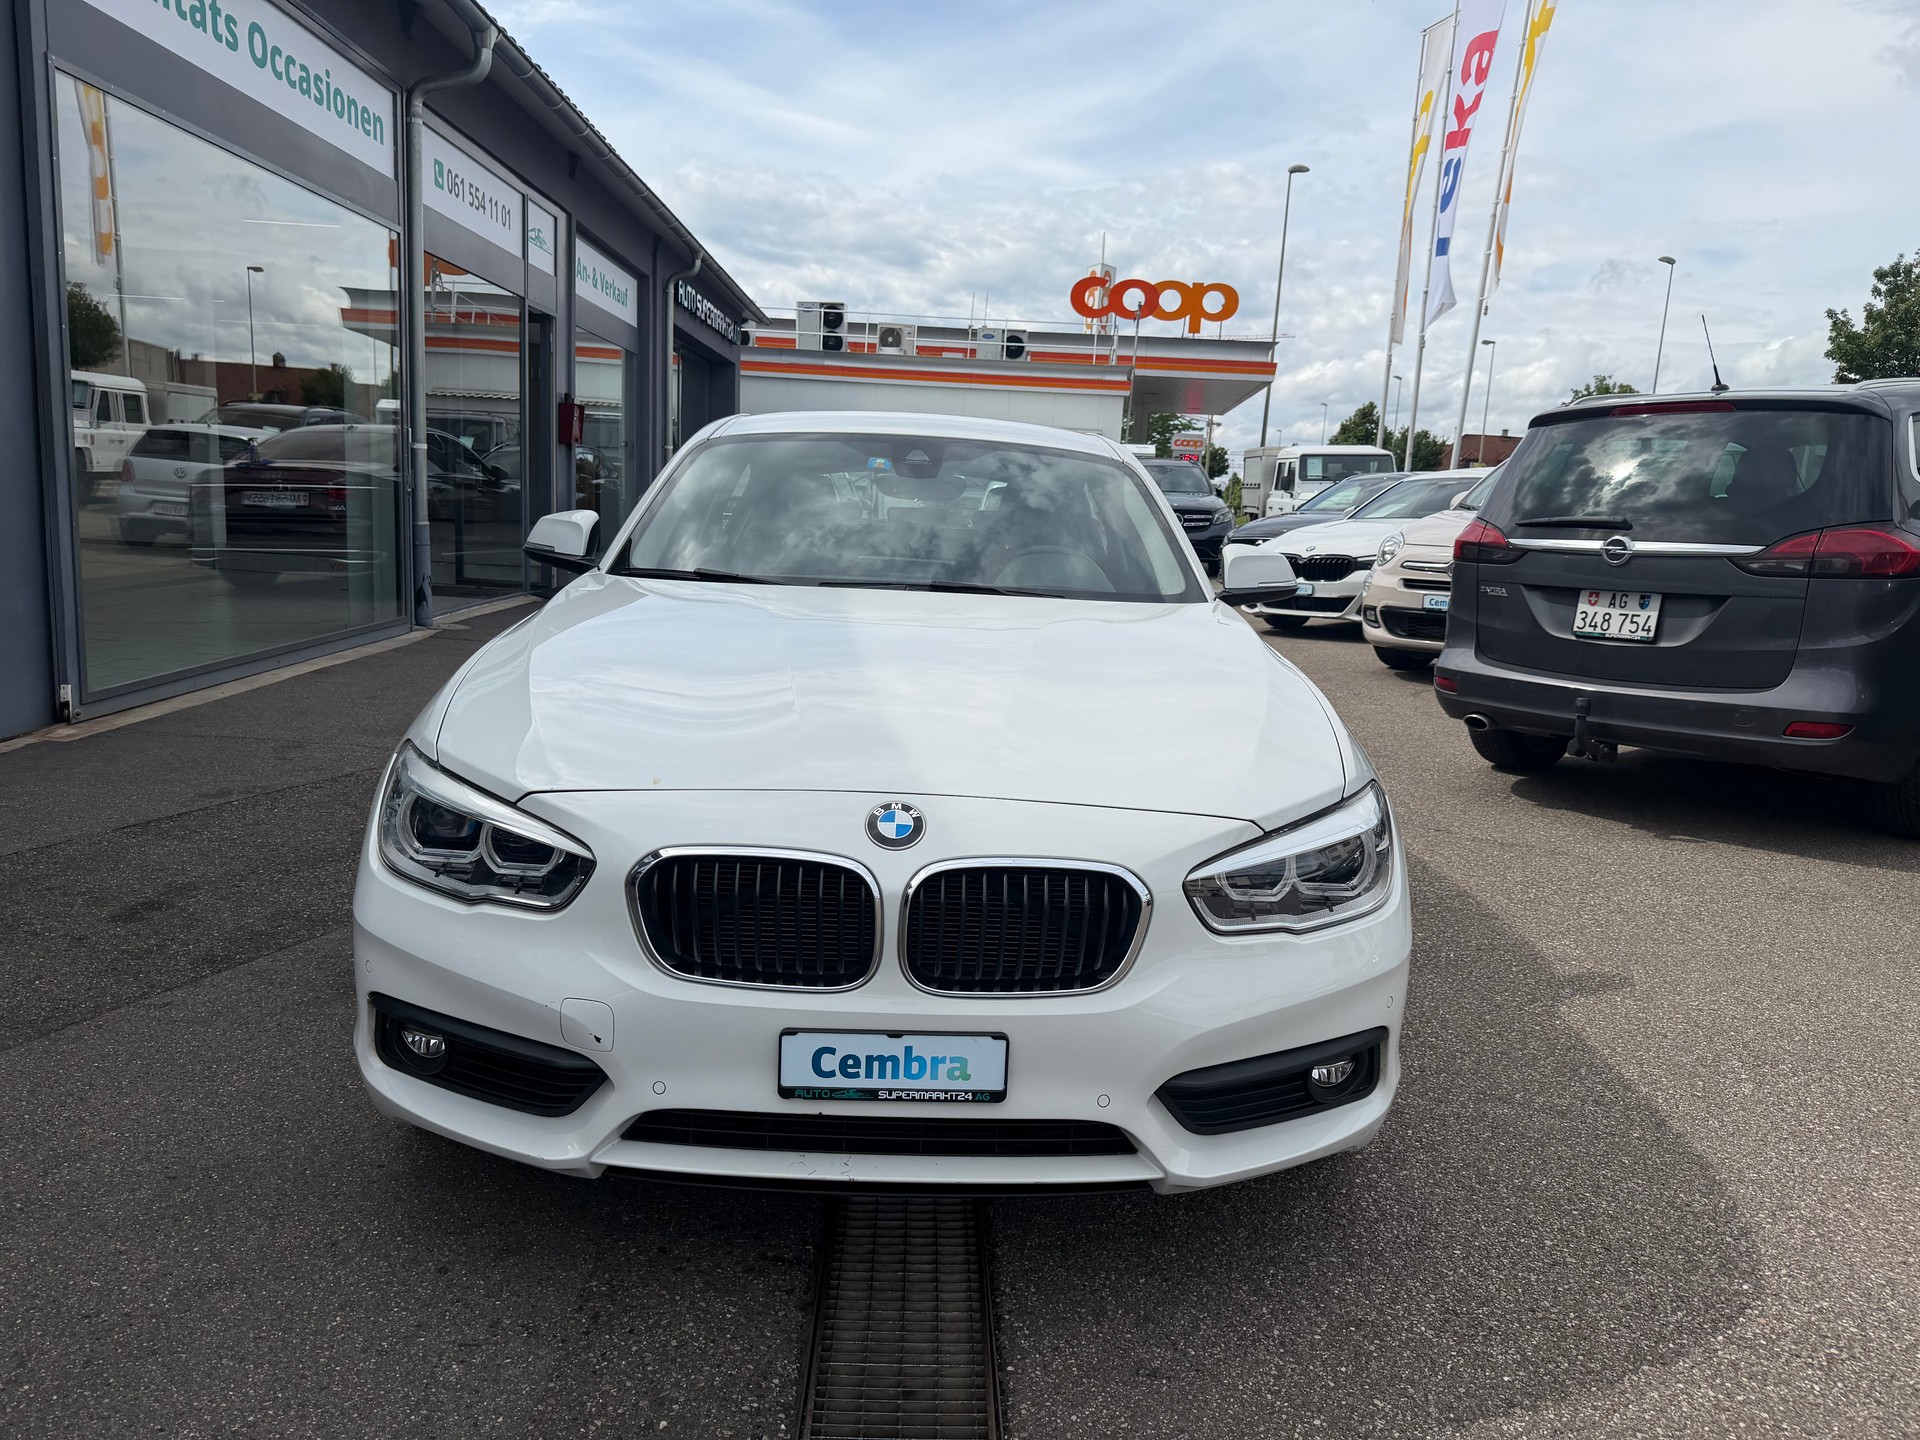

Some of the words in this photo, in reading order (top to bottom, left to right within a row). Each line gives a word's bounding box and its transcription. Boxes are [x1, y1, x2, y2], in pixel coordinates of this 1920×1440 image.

[247, 21, 384, 146] Occasionen
[446, 168, 465, 202] 061
[468, 182, 486, 215] 554
[488, 196, 499, 223] 11
[501, 204, 511, 231] 01
[576, 256, 591, 284] An-
[592, 266, 599, 290] &
[600, 271, 629, 308] Verkauf
[678, 279, 697, 313] AUTO
[1070, 276, 1240, 334] coop
[1173, 438, 1204, 449] coop
[1608, 592, 1629, 609] AG
[1576, 610, 1612, 632] 348
[1618, 612, 1652, 635] 754
[873, 803, 920, 818] BMW
[811, 1045, 972, 1082] Cembra
[795, 1089, 831, 1098] AUTO
[877, 1090, 973, 1101] SUPERMARKT24
[975, 1092, 990, 1101] AG
